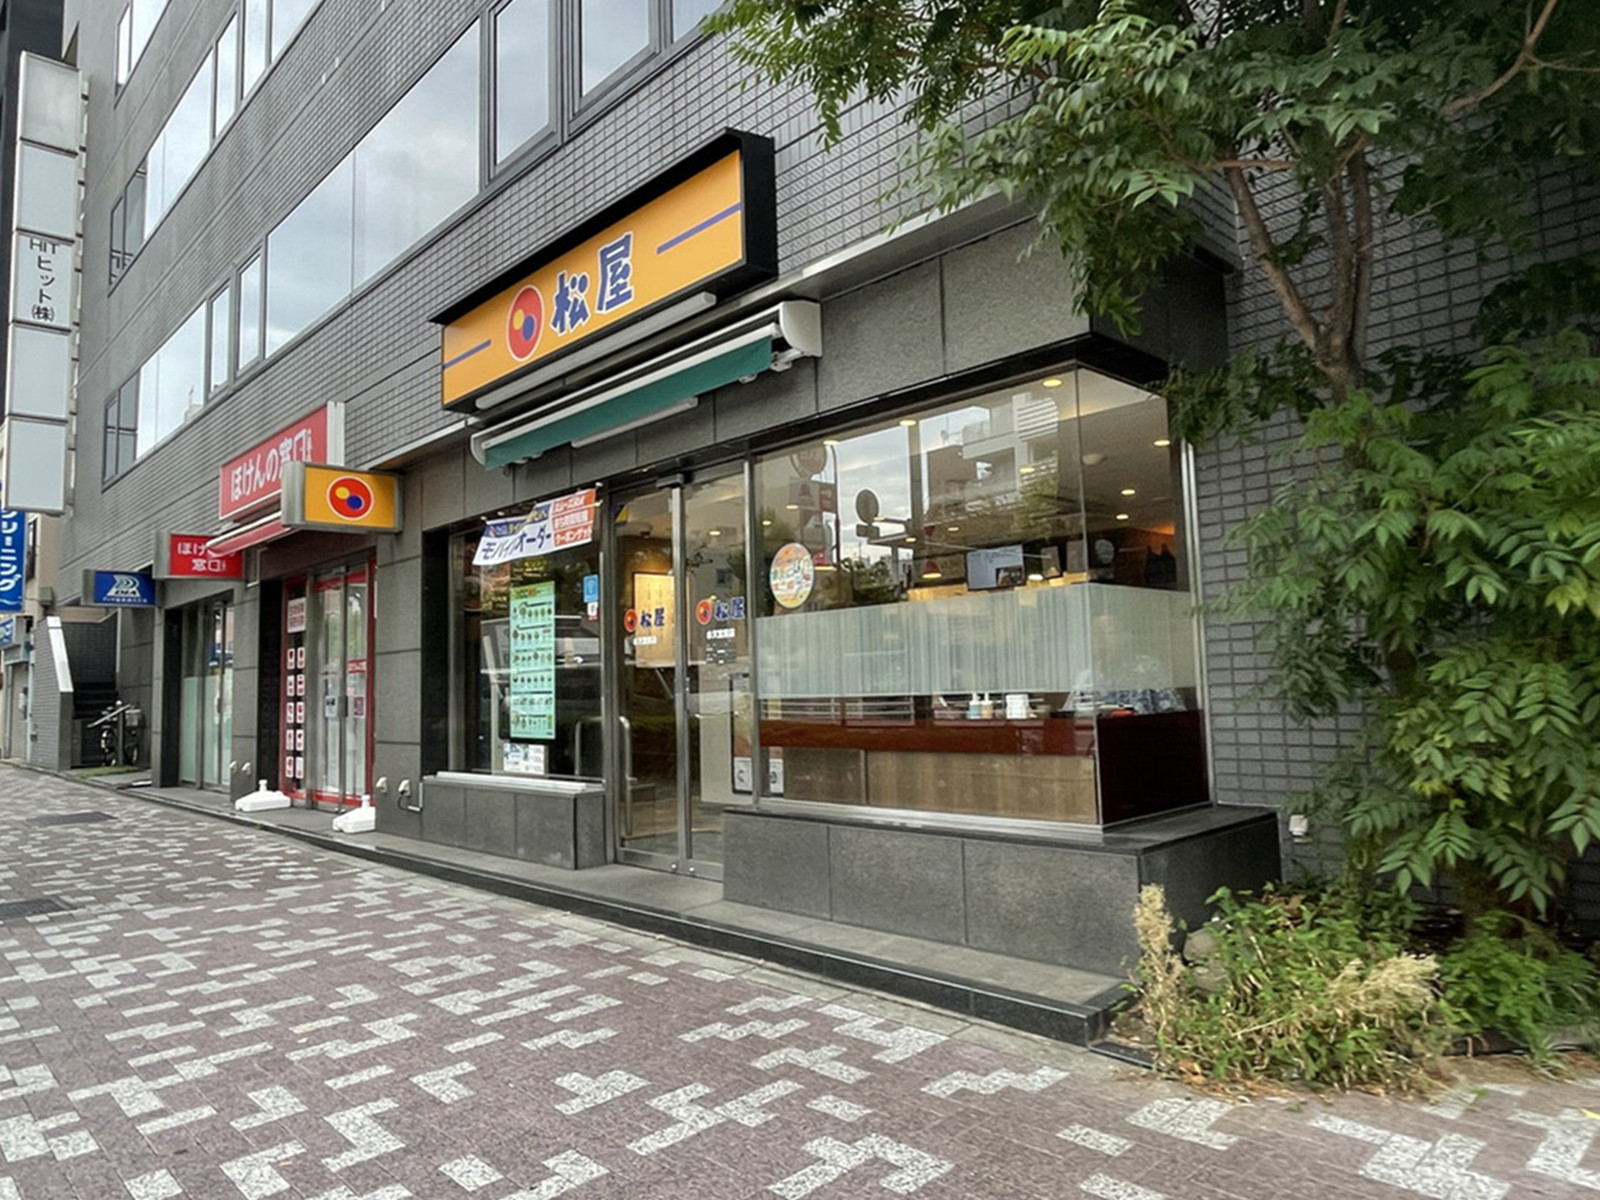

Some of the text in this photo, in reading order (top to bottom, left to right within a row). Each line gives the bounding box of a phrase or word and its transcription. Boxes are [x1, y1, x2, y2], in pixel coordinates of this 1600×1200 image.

[30, 237, 60, 254] HIT
[550, 231, 634, 336] 松屋
[230, 428, 308, 502] ほけんの窓口
[639, 607, 666, 628] 松屋
[713, 596, 746, 621] 松屋
